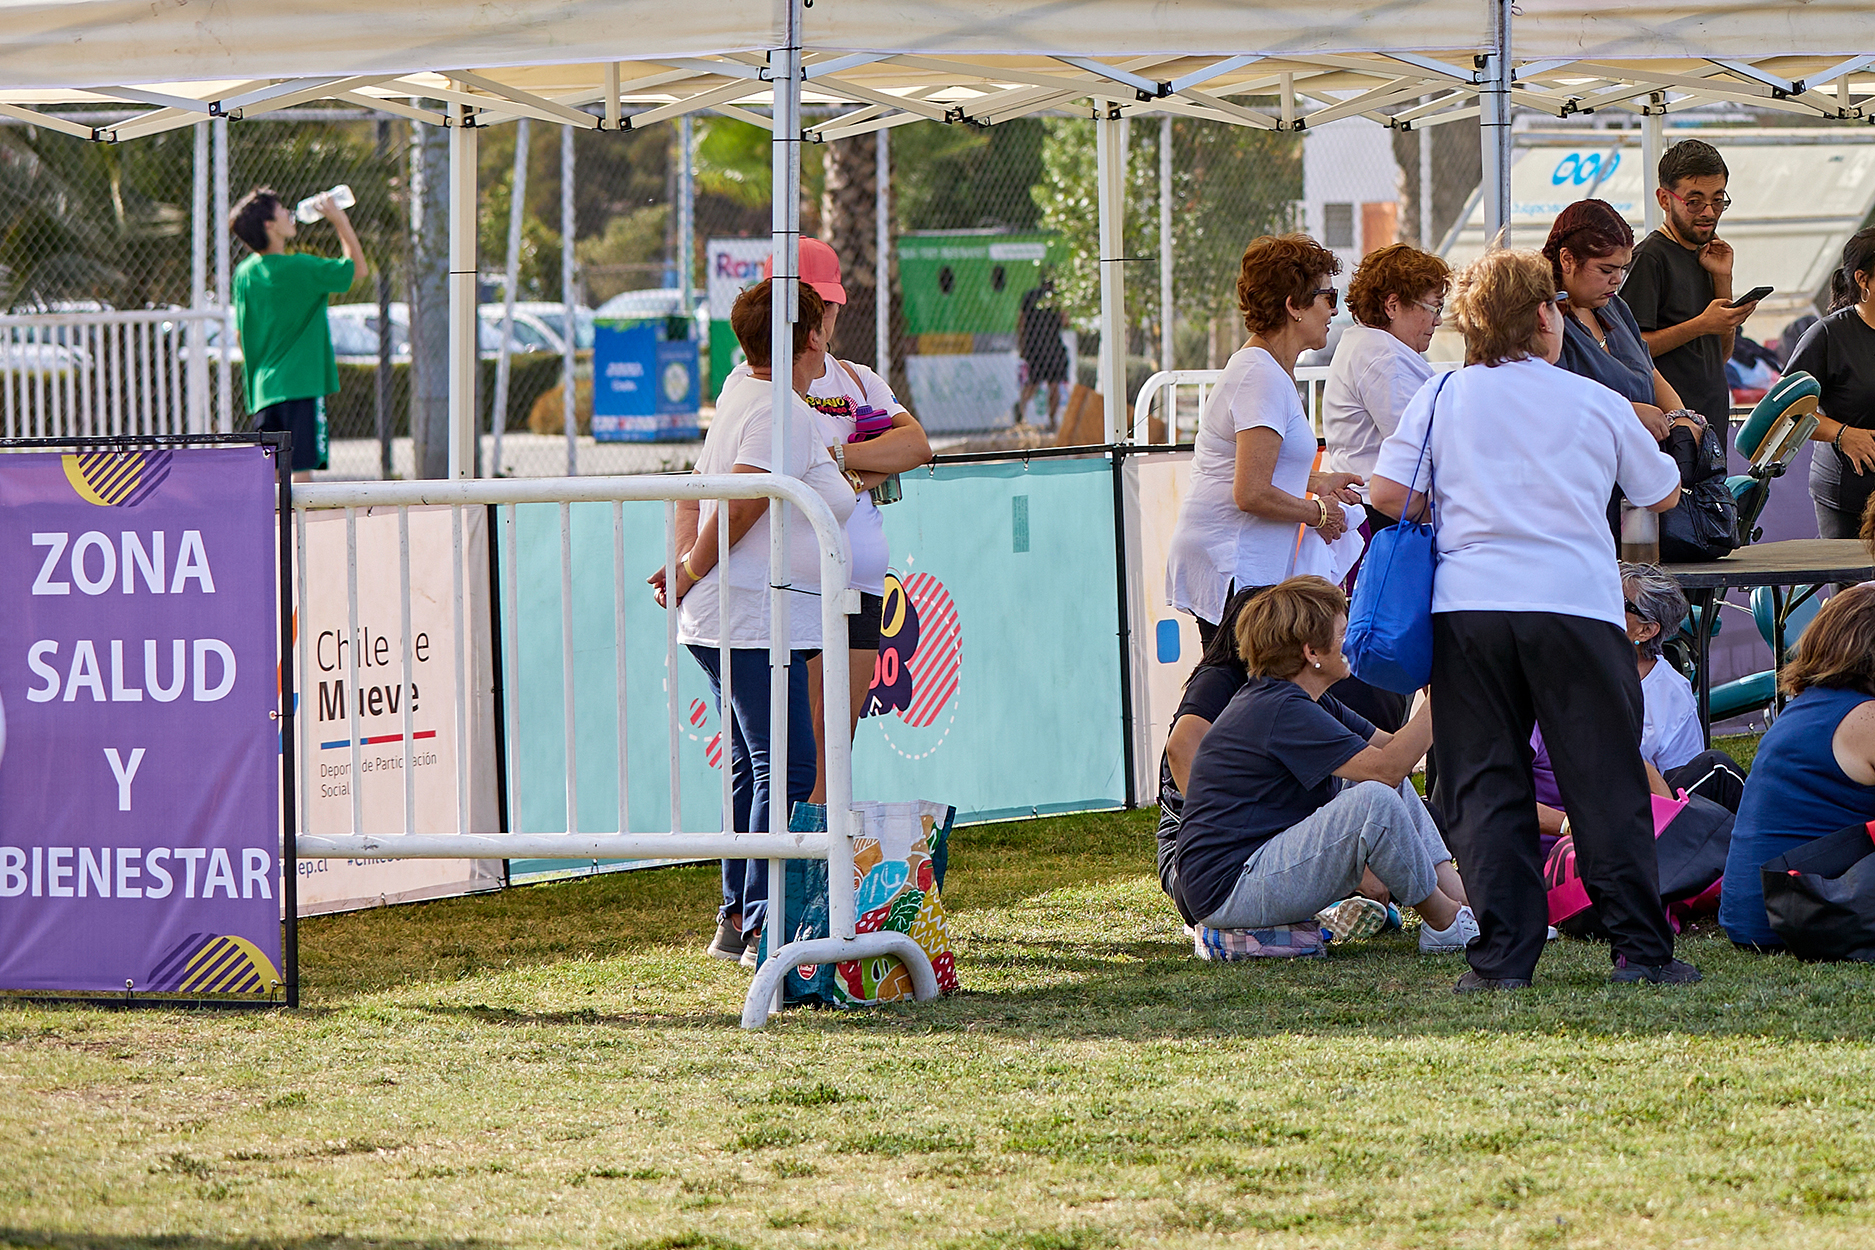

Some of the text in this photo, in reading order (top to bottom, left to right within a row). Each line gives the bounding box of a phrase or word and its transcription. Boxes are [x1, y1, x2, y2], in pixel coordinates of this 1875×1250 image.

[31, 530, 216, 596] ZONA
[26, 638, 237, 703] SALUD
[317, 626, 389, 672] Chile
[103, 747, 146, 812] Y
[362, 759, 374, 773] de
[376, 752, 437, 770] Particación
[321, 782, 351, 798] Social
[0, 846, 273, 900] BIENESTAR
